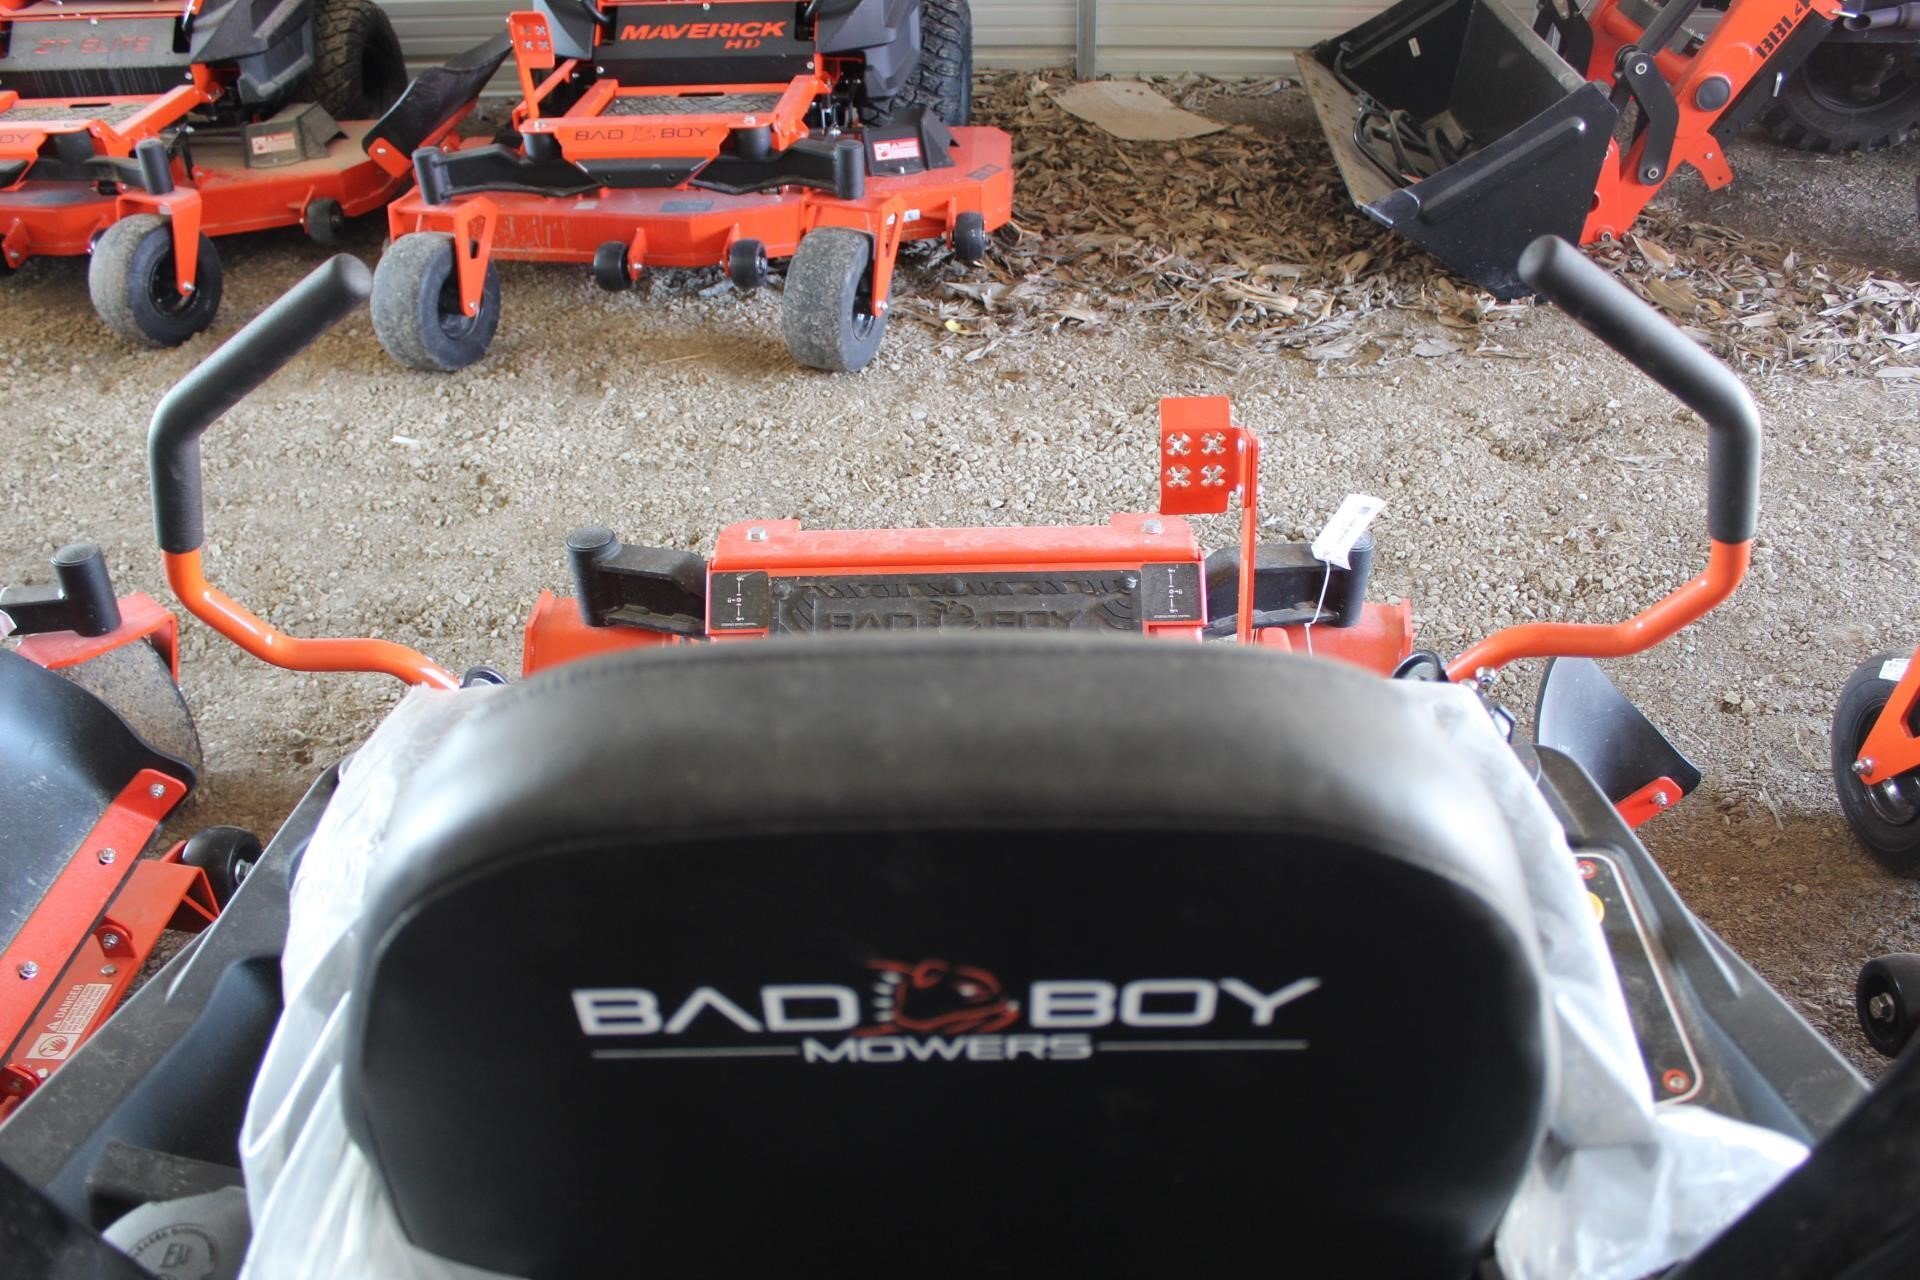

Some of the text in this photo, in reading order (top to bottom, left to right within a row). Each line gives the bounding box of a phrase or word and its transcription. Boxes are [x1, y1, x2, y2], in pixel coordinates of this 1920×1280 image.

[620, 21, 788, 40] MAVERICK
[32, 34, 153, 55] ZT ELITE
[724, 38, 761, 49] HD
[575, 127, 711, 141] BAD BOY
[54, 984, 85, 1018] DANGER
[572, 977, 1322, 1035] BAD BOY
[802, 1033, 1093, 1063] MOWERS
